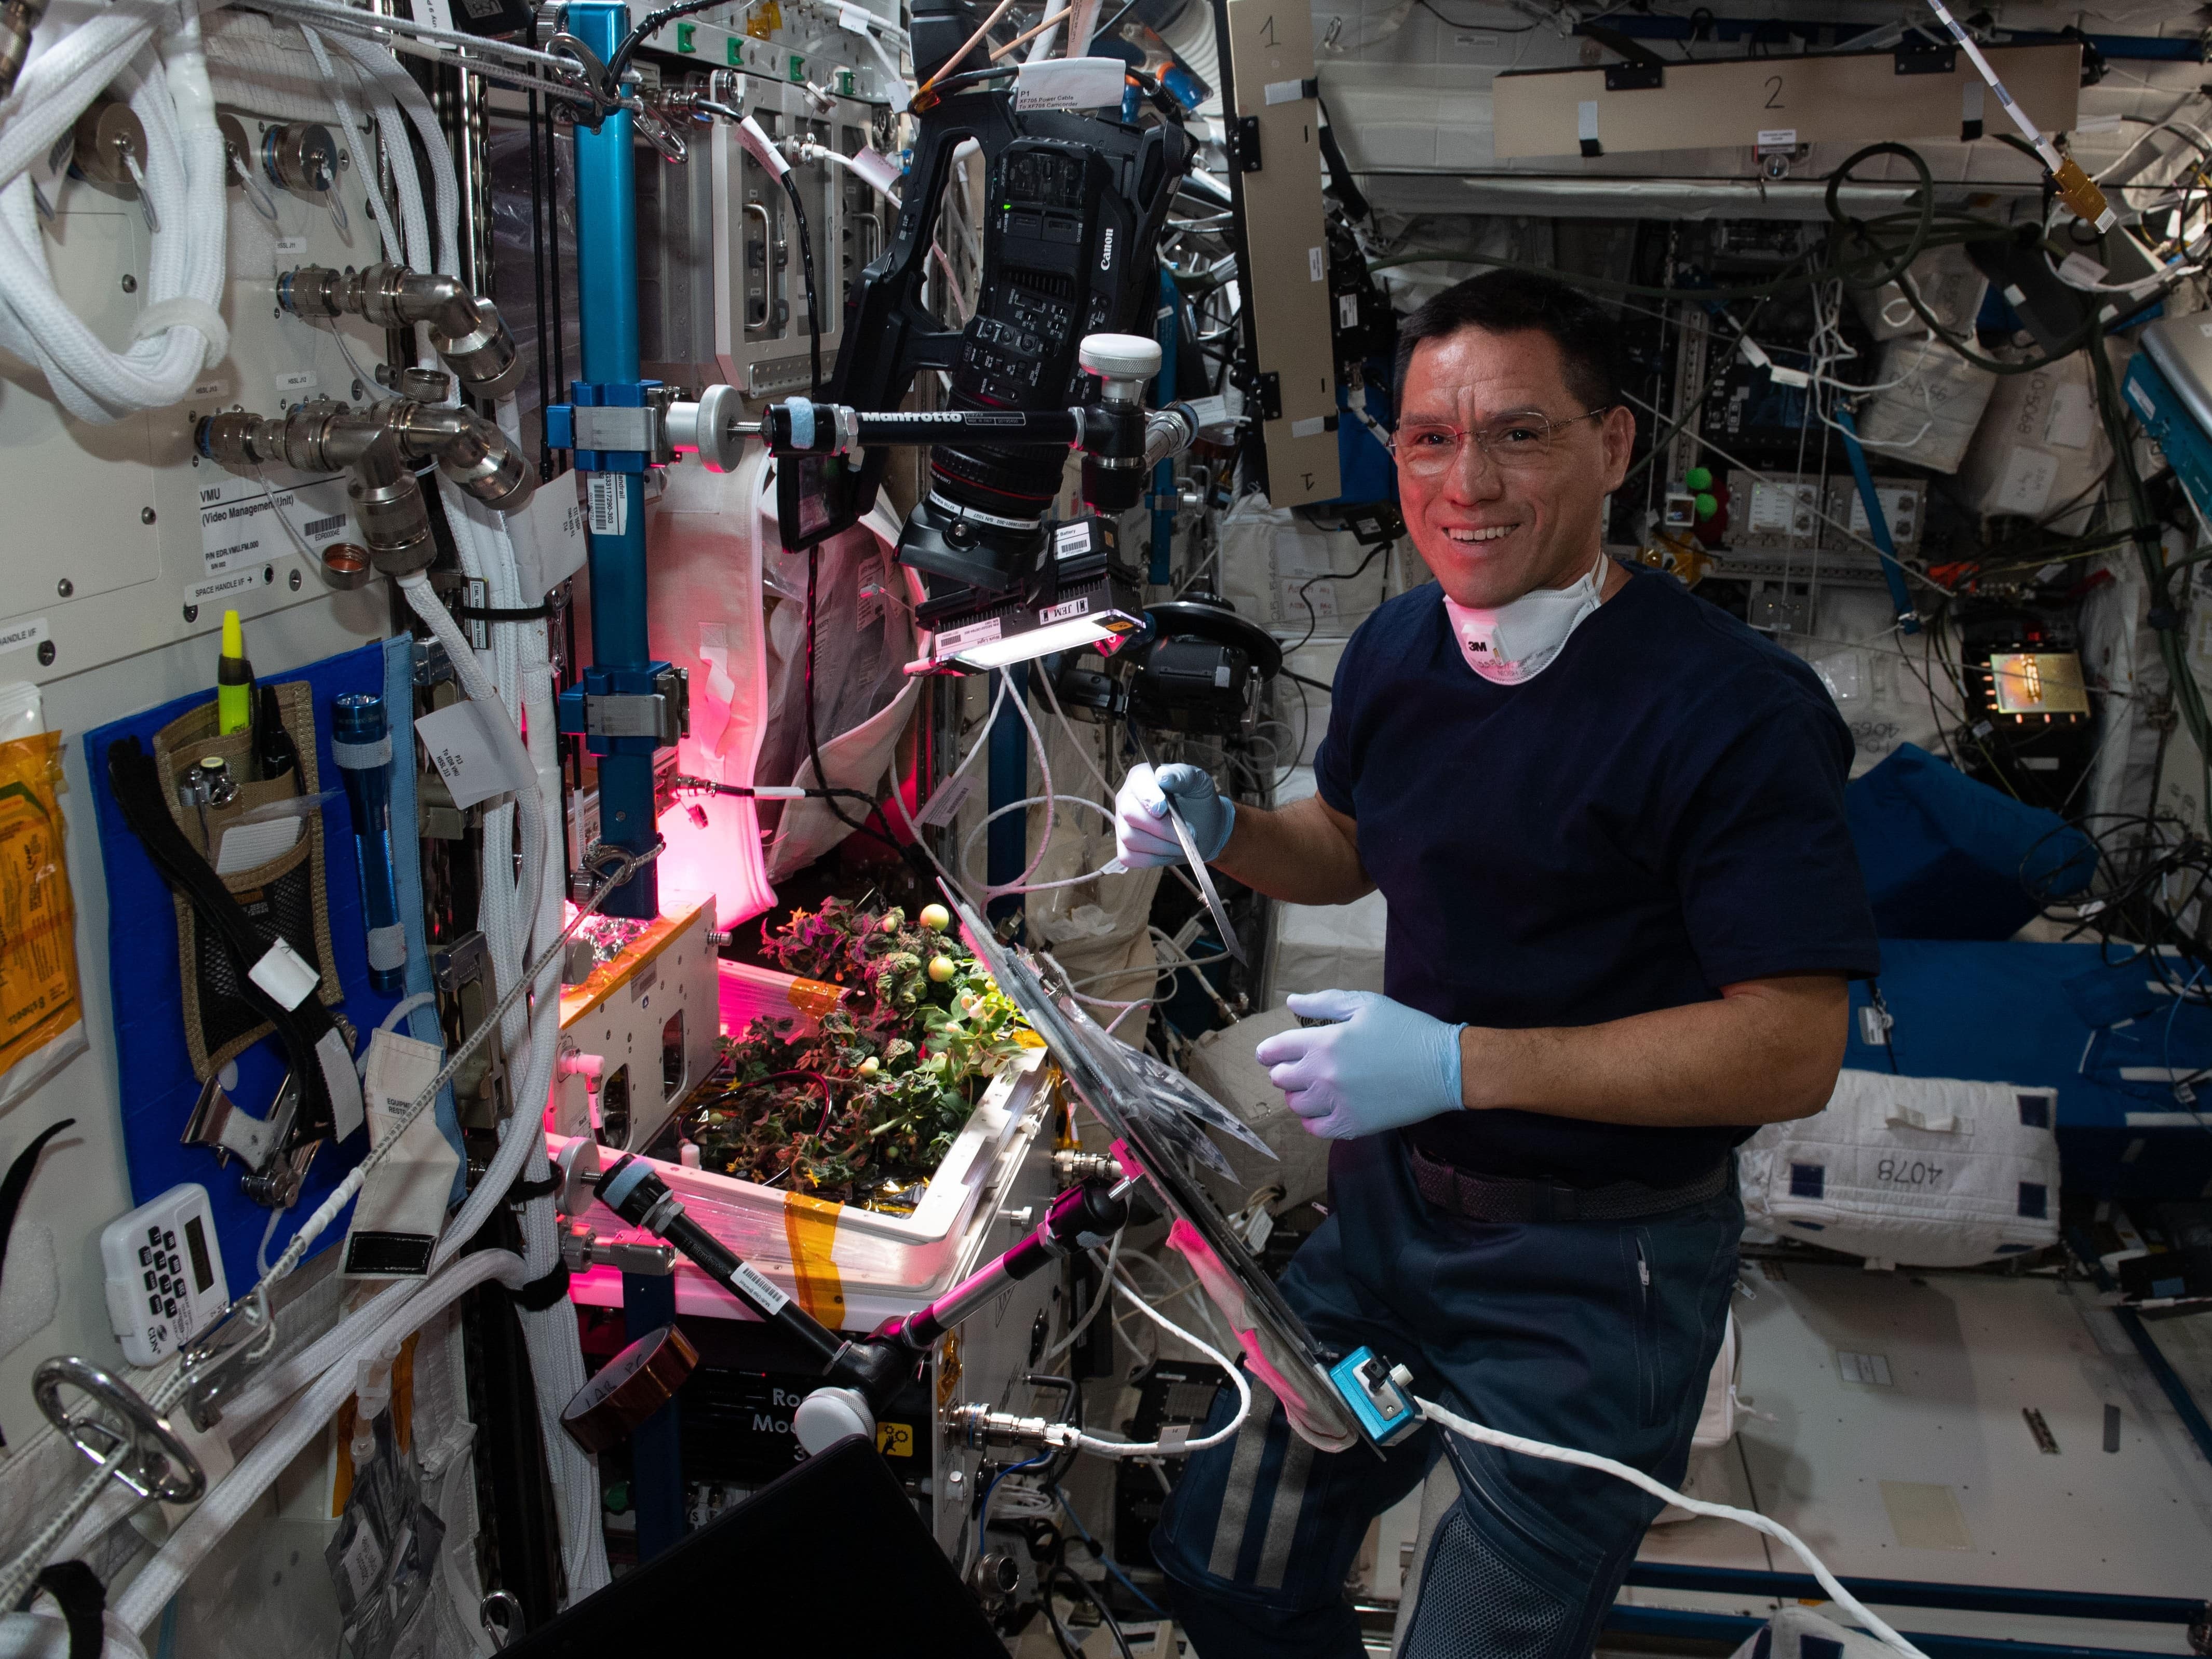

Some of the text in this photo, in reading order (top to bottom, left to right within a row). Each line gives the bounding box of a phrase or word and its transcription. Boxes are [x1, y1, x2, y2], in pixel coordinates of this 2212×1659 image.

[1261, 15, 1281, 48] 1
[1764, 76, 1785, 109] 2
[1100, 228, 1114, 271] Canon
[861, 412, 962, 422] Manfrotto
[1302, 472, 1316, 491] 1
[200, 488, 221, 503] VMU
[202, 511, 227, 527] (Video
[228, 501, 277, 518] Managemen
[205, 541, 259, 560] P/N EDR.VMU.FM.000
[195, 586, 214, 597] SPACE
[215, 581, 237, 592] HANDLE
[1054, 604, 1072, 617] JEM
[977, 637, 988, 645] Light
[1468, 641, 1488, 652] 3M
[437, 756, 451, 777] HSSL J13
[446, 756, 455, 767] EDR
[451, 765, 460, 777] VMU
[454, 754, 463, 765] P13
[1877, 1157, 1941, 1184] 4078
[154, 1232, 161, 1241] T1
[158, 1257, 165, 1265] T2
[172, 1259, 181, 1271] MIN
[163, 1280, 171, 1289] T3
[177, 1284, 185, 1295] SEC
[168, 1304, 176, 1313] T4
[147, 1327, 158, 1353] CDN
[773, 1388, 807, 1407] Ro
[793, 1444, 806, 1461] 3
